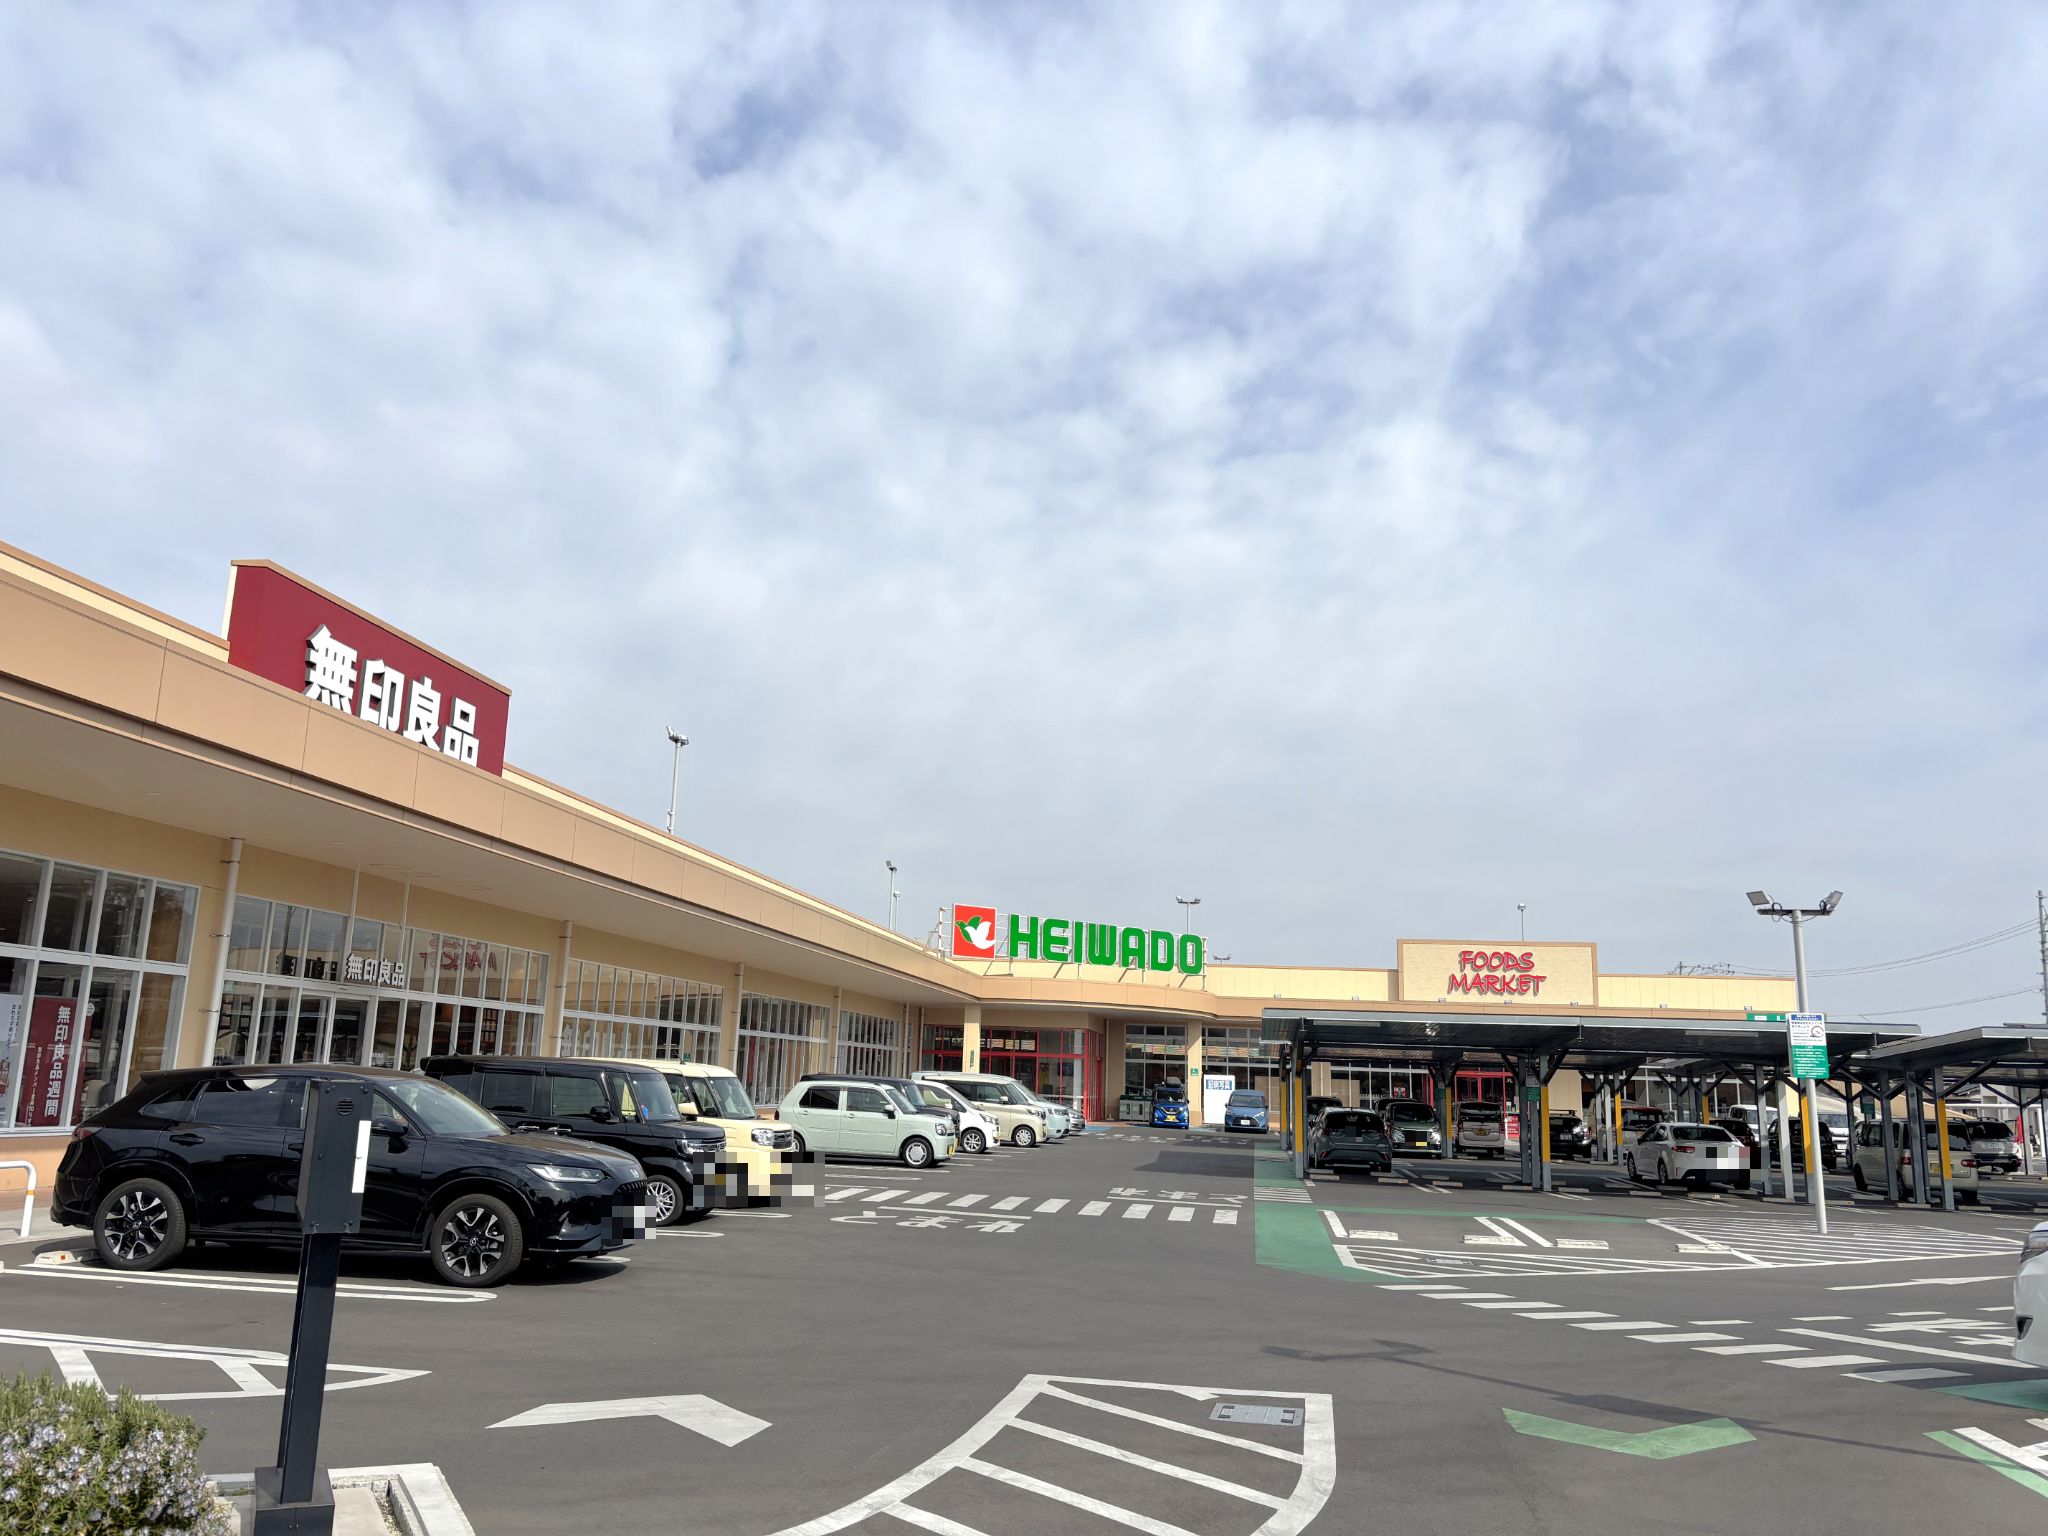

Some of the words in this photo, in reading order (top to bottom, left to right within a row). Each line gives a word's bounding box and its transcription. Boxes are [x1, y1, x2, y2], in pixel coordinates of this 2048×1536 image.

[303, 624, 479, 767] 無印良品
[1009, 913, 1204, 975] HEIWADO
[1459, 950, 1536, 971] FOODS
[346, 953, 405, 987] 無印良品
[1448, 972, 1548, 994] MARKET
[45, 1005, 72, 1118] 無印良品週間
[829, 1210, 1026, 1233] とまれ
